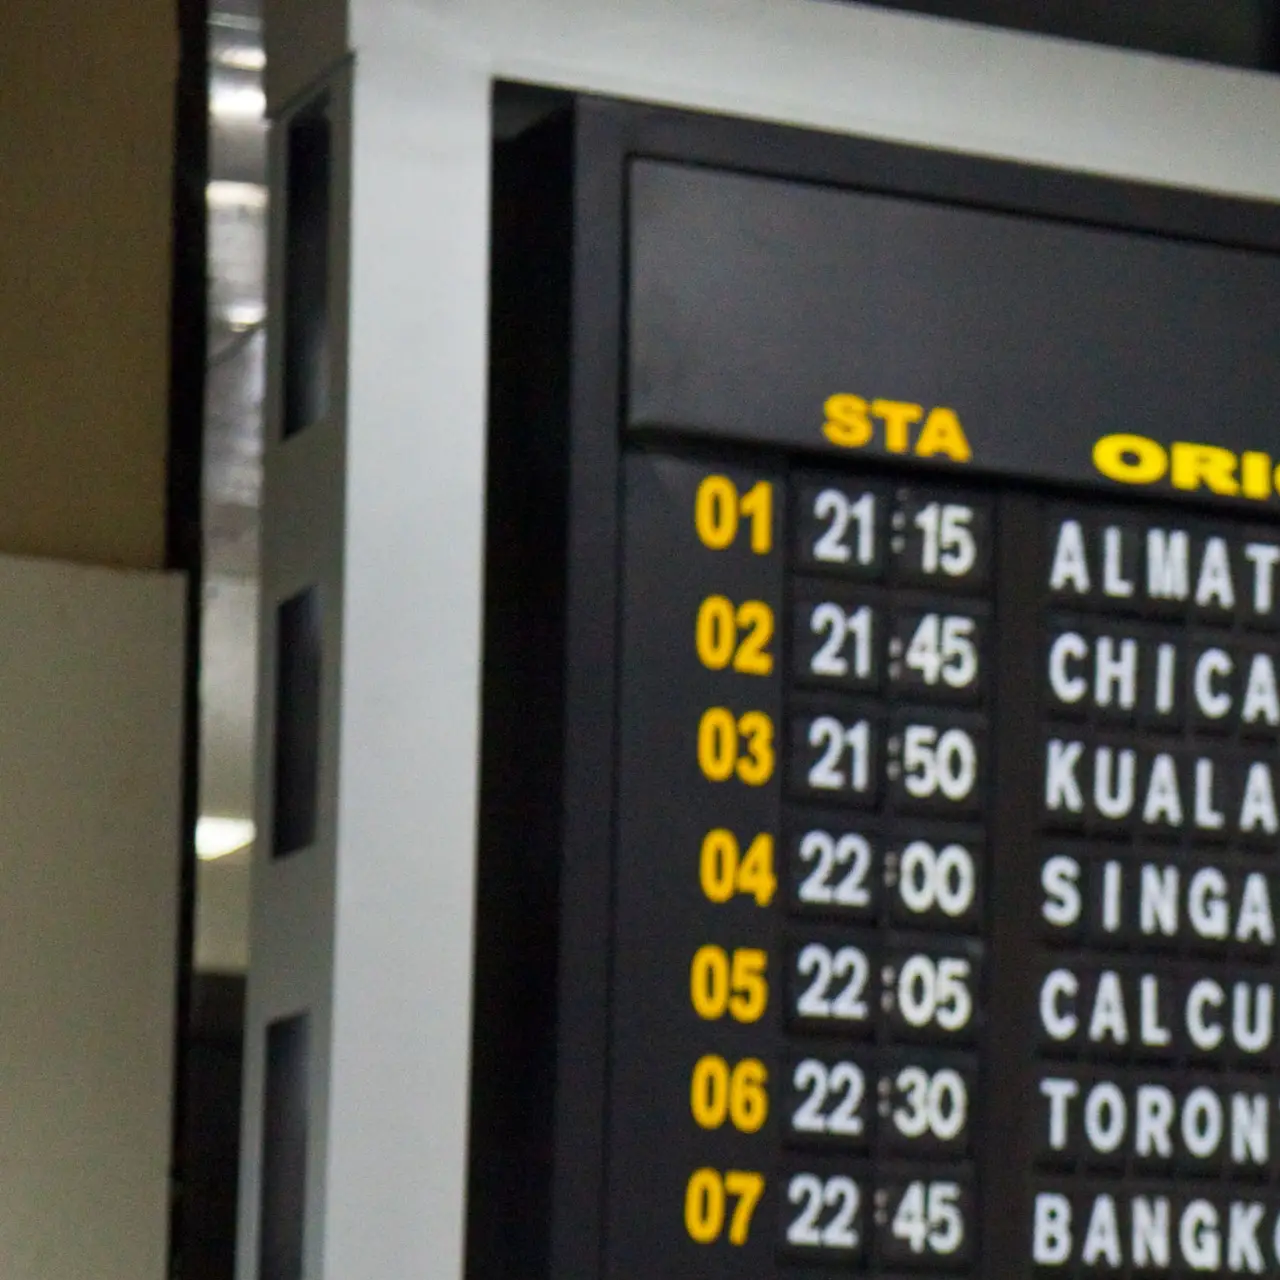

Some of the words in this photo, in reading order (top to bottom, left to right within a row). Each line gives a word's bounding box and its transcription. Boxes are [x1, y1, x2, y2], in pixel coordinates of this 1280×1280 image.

[824, 394, 970, 461] STA
[696, 476, 770, 552] 01
[697, 597, 772, 673] 02
[699, 709, 773, 783] 03
[1047, 741, 1277, 831] KUALA
[701, 831, 775, 904] 04
[692, 947, 766, 1021] 05
[692, 1057, 766, 1131] 06
[686, 1169, 762, 1243] 07
